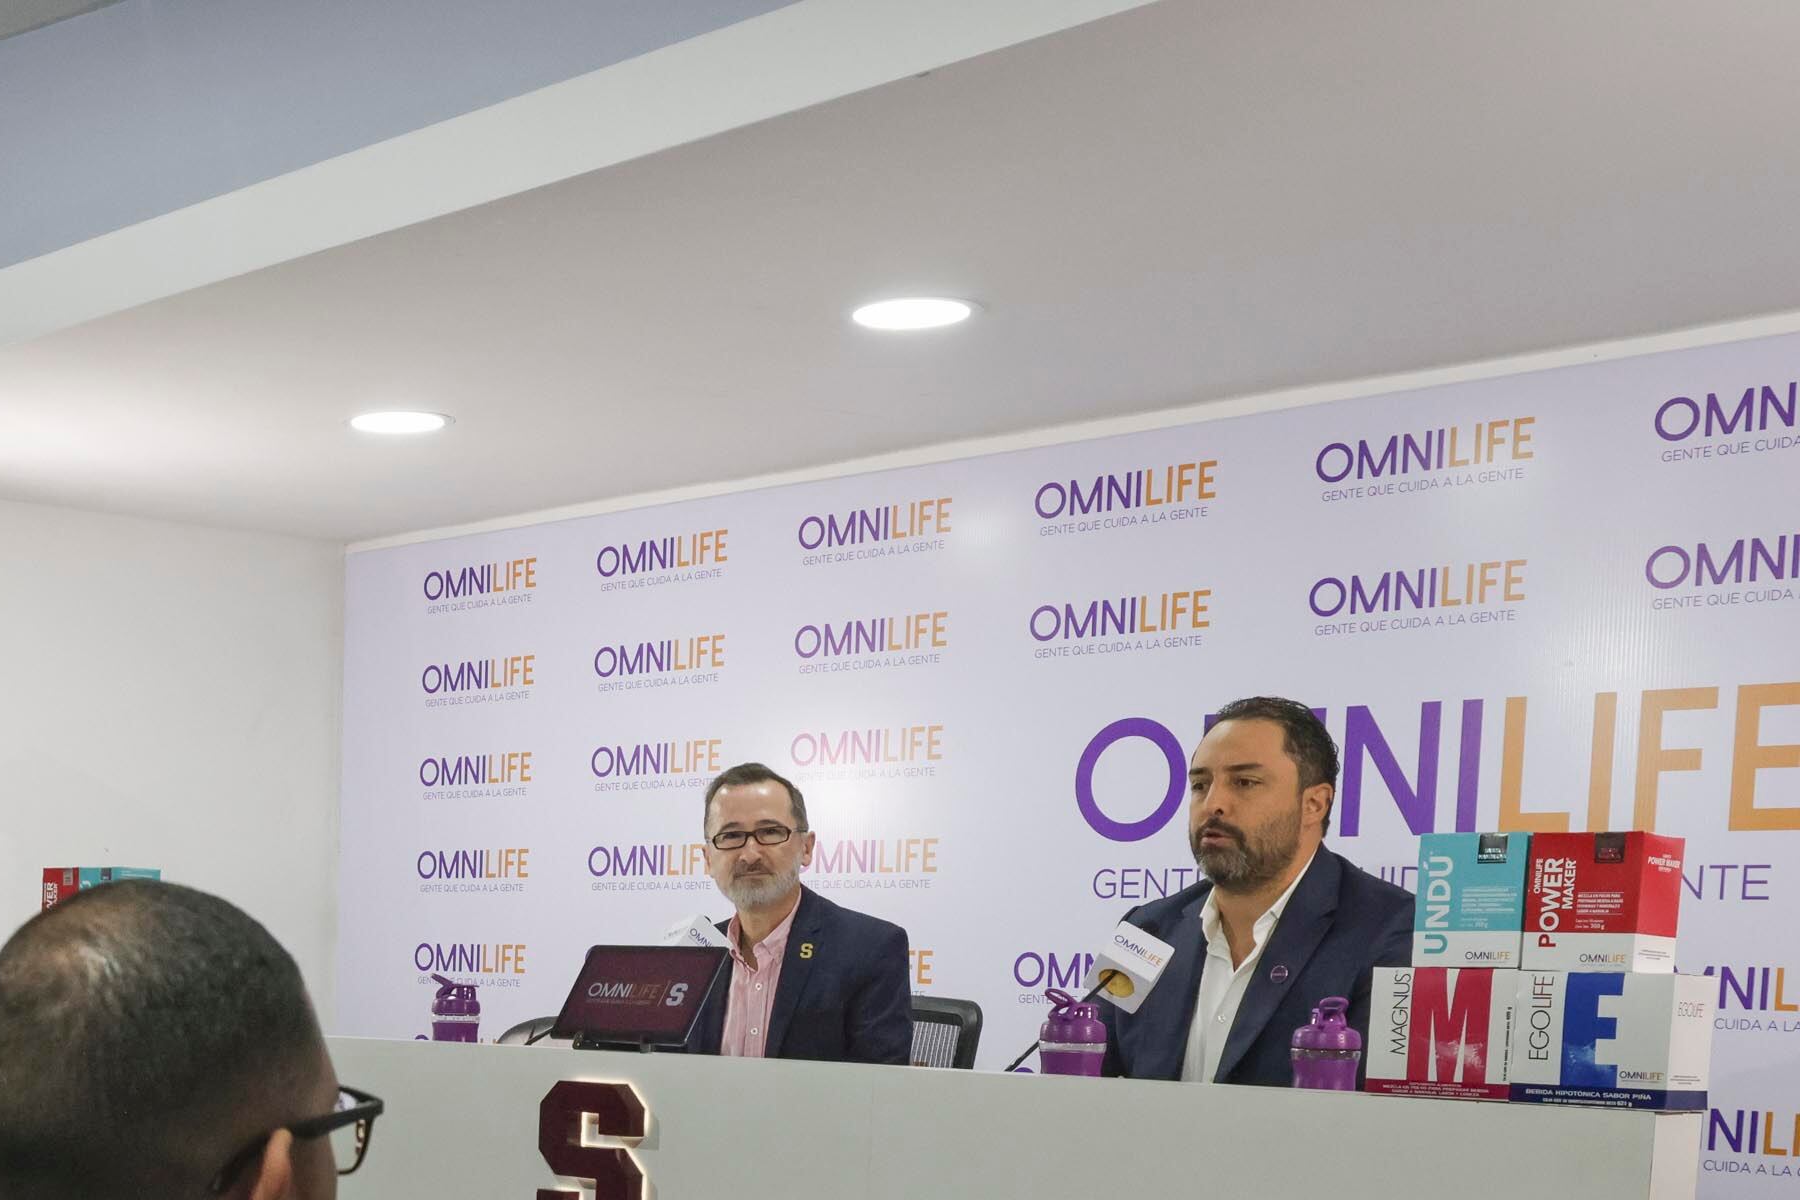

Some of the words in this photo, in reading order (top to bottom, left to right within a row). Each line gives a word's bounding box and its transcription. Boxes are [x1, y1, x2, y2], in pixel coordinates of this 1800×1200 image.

[1316, 417, 1535, 483] OMNILIFE
[1661, 446, 1712, 462] GENTE
[1717, 442, 1750, 456] QUE
[1035, 460, 1217, 519] OMNILIFE
[1322, 487, 1363, 502] GENTE
[1368, 484, 1394, 497] QUE
[1398, 478, 1439, 493] CUIDA
[1443, 477, 1452, 487] A
[1456, 473, 1473, 485] LA
[1478, 468, 1524, 482] GENTE
[798, 498, 952, 550] OMNILIFE
[1040, 523, 1075, 536] GENTE
[1078, 520, 1100, 532] QUE
[1104, 516, 1137, 529] CUIDA
[1141, 515, 1149, 524] A
[1152, 512, 1166, 523] LA
[1170, 507, 1208, 520] GENTE
[597, 529, 728, 577] OMNILIFE
[803, 554, 832, 566] GENTE
[835, 552, 854, 562] QUE
[857, 547, 885, 560] CUIDA
[897, 544, 910, 554] LA
[912, 540, 944, 552] GENTE
[424, 558, 536, 600] OMNILIFE
[601, 580, 627, 592] GENTE
[628, 579, 645, 589] QUE
[647, 576, 671, 587] CUIDA
[682, 572, 692, 581] LA
[694, 569, 722, 580] GENTE
[1309, 559, 1527, 617] OMNILIFE
[428, 604, 449, 614] GENTE
[451, 601, 466, 612] QUE
[468, 599, 488, 610] CUIDA
[497, 597, 506, 605] LA
[508, 594, 532, 604] GENTE
[1652, 597, 1702, 610] GENTE
[1707, 593, 1740, 606] QUE
[1744, 589, 1793, 603] CUIDA
[1030, 590, 1211, 641] OMNILIFE
[1315, 623, 1357, 636] GENTE
[1360, 620, 1387, 632] QUE
[1391, 616, 1431, 630] CUIDA
[1435, 616, 1444, 625] A
[1449, 614, 1466, 625] LA
[1470, 610, 1516, 623] GENTE
[795, 611, 948, 658] OMNILIFE
[1034, 647, 1069, 658] GENTE
[1072, 645, 1095, 656] QUE
[1098, 642, 1132, 654] CUIDA
[1135, 640, 1143, 649] A
[1146, 639, 1161, 649] LA
[1164, 636, 1202, 648] GENTE
[594, 635, 725, 677] OMNILIFE
[799, 663, 829, 674] GENTE
[831, 661, 850, 672] QUE
[853, 658, 881, 670] CUIDA
[893, 657, 905, 666] LA
[908, 654, 940, 665] GENTE
[423, 655, 535, 693] OMNILIFE
[598, 682, 624, 692] GENTE
[625, 680, 642, 690] QUE
[644, 677, 669, 688] CUIDA
[678, 675, 689, 685] LA
[691, 673, 719, 683] GENTE
[425, 698, 448, 707] GENTE
[450, 697, 463, 705] QUE
[465, 695, 486, 705] CUIDA
[495, 693, 504, 701] LA
[506, 691, 529, 700] GENTE
[592, 739, 722, 777] OMNILIFE
[791, 725, 944, 766] OMNILIFE
[420, 752, 532, 786] OMNILIFE
[903, 767, 936, 777] GENTE
[1075, 682, 1800, 842] ONILIFE
[423, 792, 445, 800] GENTE
[446, 791, 460, 799] QUE
[462, 789, 483, 798] CUIDA
[503, 788, 526, 796] GENTE
[595, 783, 620, 791] GENTE
[622, 782, 638, 790] QUE
[641, 780, 664, 789] CUIDA
[675, 778, 686, 787] LA
[418, 849, 529, 879] OMNILIFE
[800, 838, 939, 874] MNILIFE
[420, 884, 442, 892] GENTE
[444, 884, 458, 892] QUE
[460, 884, 480, 892] CUIDA
[592, 882, 616, 891] GENTE
[619, 882, 635, 890] QUE
[637, 882, 661, 890] CUIDA
[672, 881, 682, 889] LA
[685, 881, 711, 889] GENTE
[823, 880, 842, 888] QUE
[844, 879, 872, 888] CUIDA
[884, 879, 897, 888] LA
[899, 879, 931, 888] GENTE
[1534, 858, 1544, 894] OMNILIFE
[1562, 860, 1576, 910] MAKER
[1423, 856, 1453, 954] UNDÚ
[1538, 858, 1564, 947] POWER
[415, 943, 526, 974] OMNILIFE
[800, 943, 814, 958] S
[1114, 934, 1163, 967] OMNILIFE
[1465, 951, 1511, 960] OMNILIFE
[1579, 954, 1626, 963] OMNILIFE
[487, 978, 496, 987] LA
[497, 979, 520, 987] GENTE
[588, 982, 659, 998] OMNILIFE
[1389, 973, 1411, 1055] MAGNUS
[1528, 975, 1554, 1061] EGOLIFE
[1714, 1018, 1762, 1030] CUIDA
[1768, 1021, 1779, 1031] A
[1784, 1022, 1800, 1032] LA
[1619, 1071, 1664, 1081] OMNILIFE
[1703, 1160, 1751, 1174] CUIDA
[1756, 1162, 1767, 1175] A
[1772, 1165, 1792, 1176] LA
